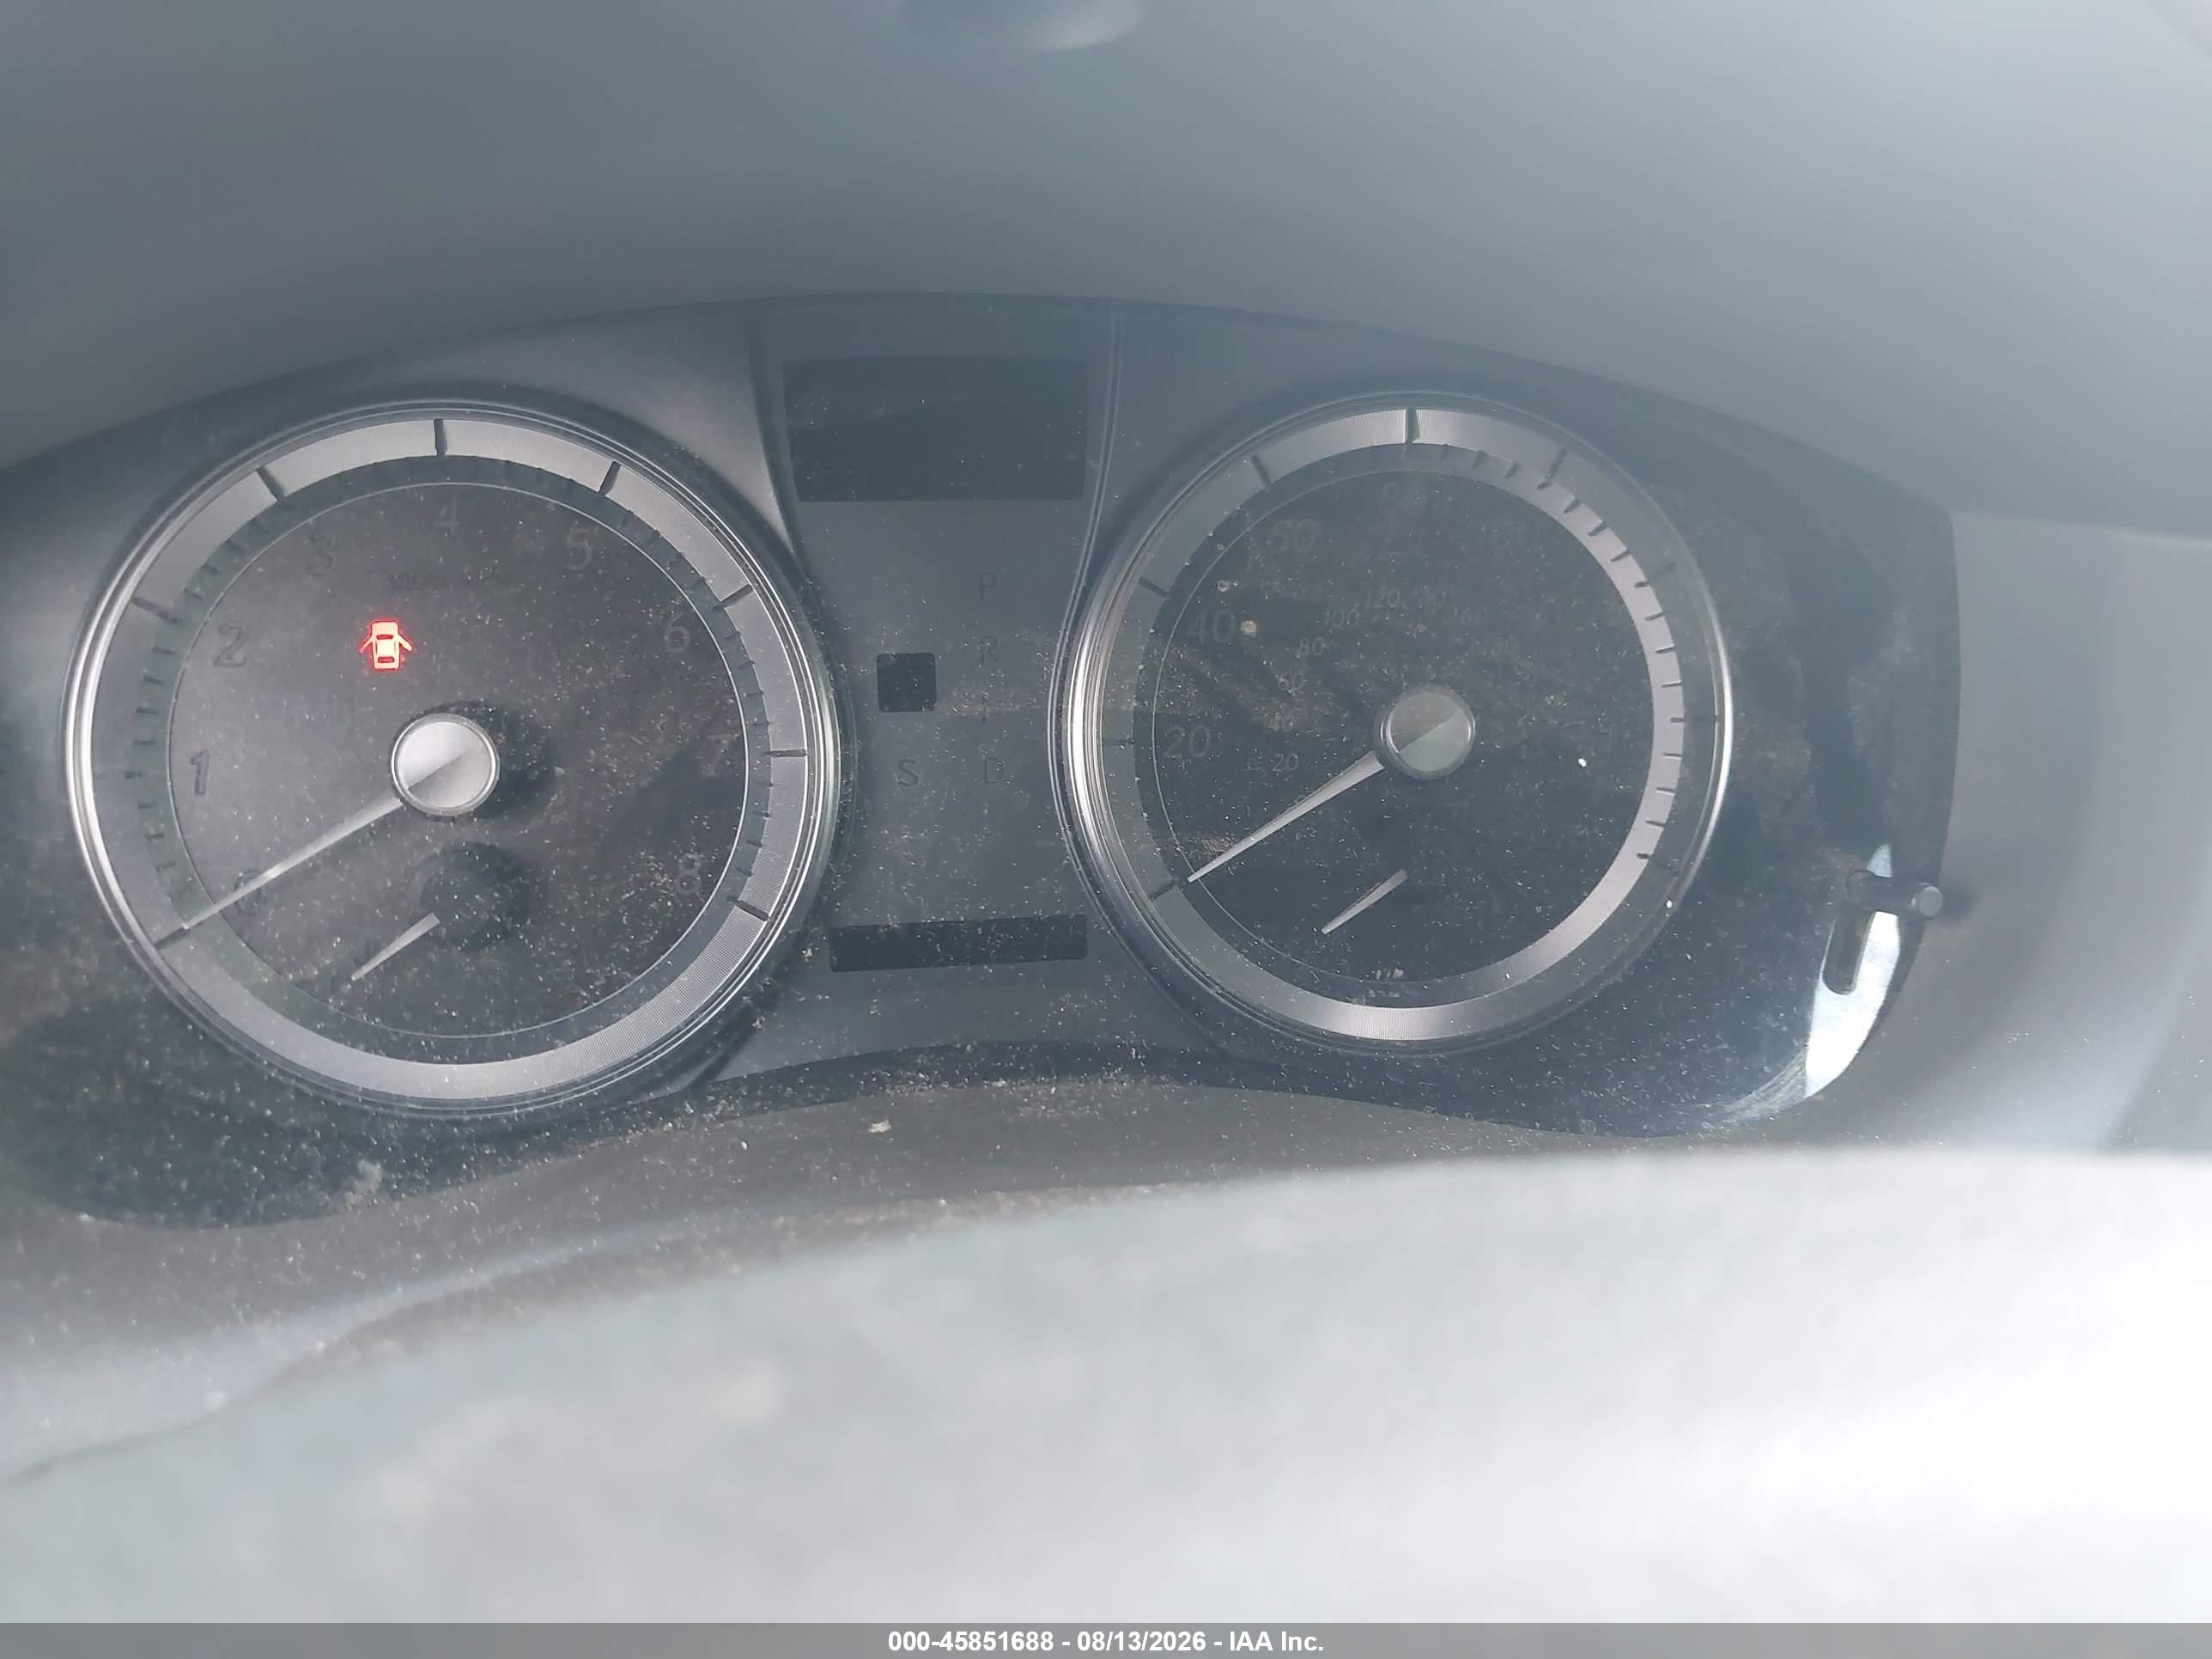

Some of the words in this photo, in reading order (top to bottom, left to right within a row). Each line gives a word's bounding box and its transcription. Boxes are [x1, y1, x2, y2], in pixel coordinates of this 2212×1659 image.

[976, 571, 999, 602] P
[664, 611, 690, 653] 6
[1187, 607, 1236, 644] 40
[213, 622, 249, 668] 2
[1163, 724, 1212, 759] 20
[189, 748, 210, 796] 1
[896, 757, 921, 788] S
[983, 757, 1005, 786] D
[1272, 752, 1300, 773] 20
